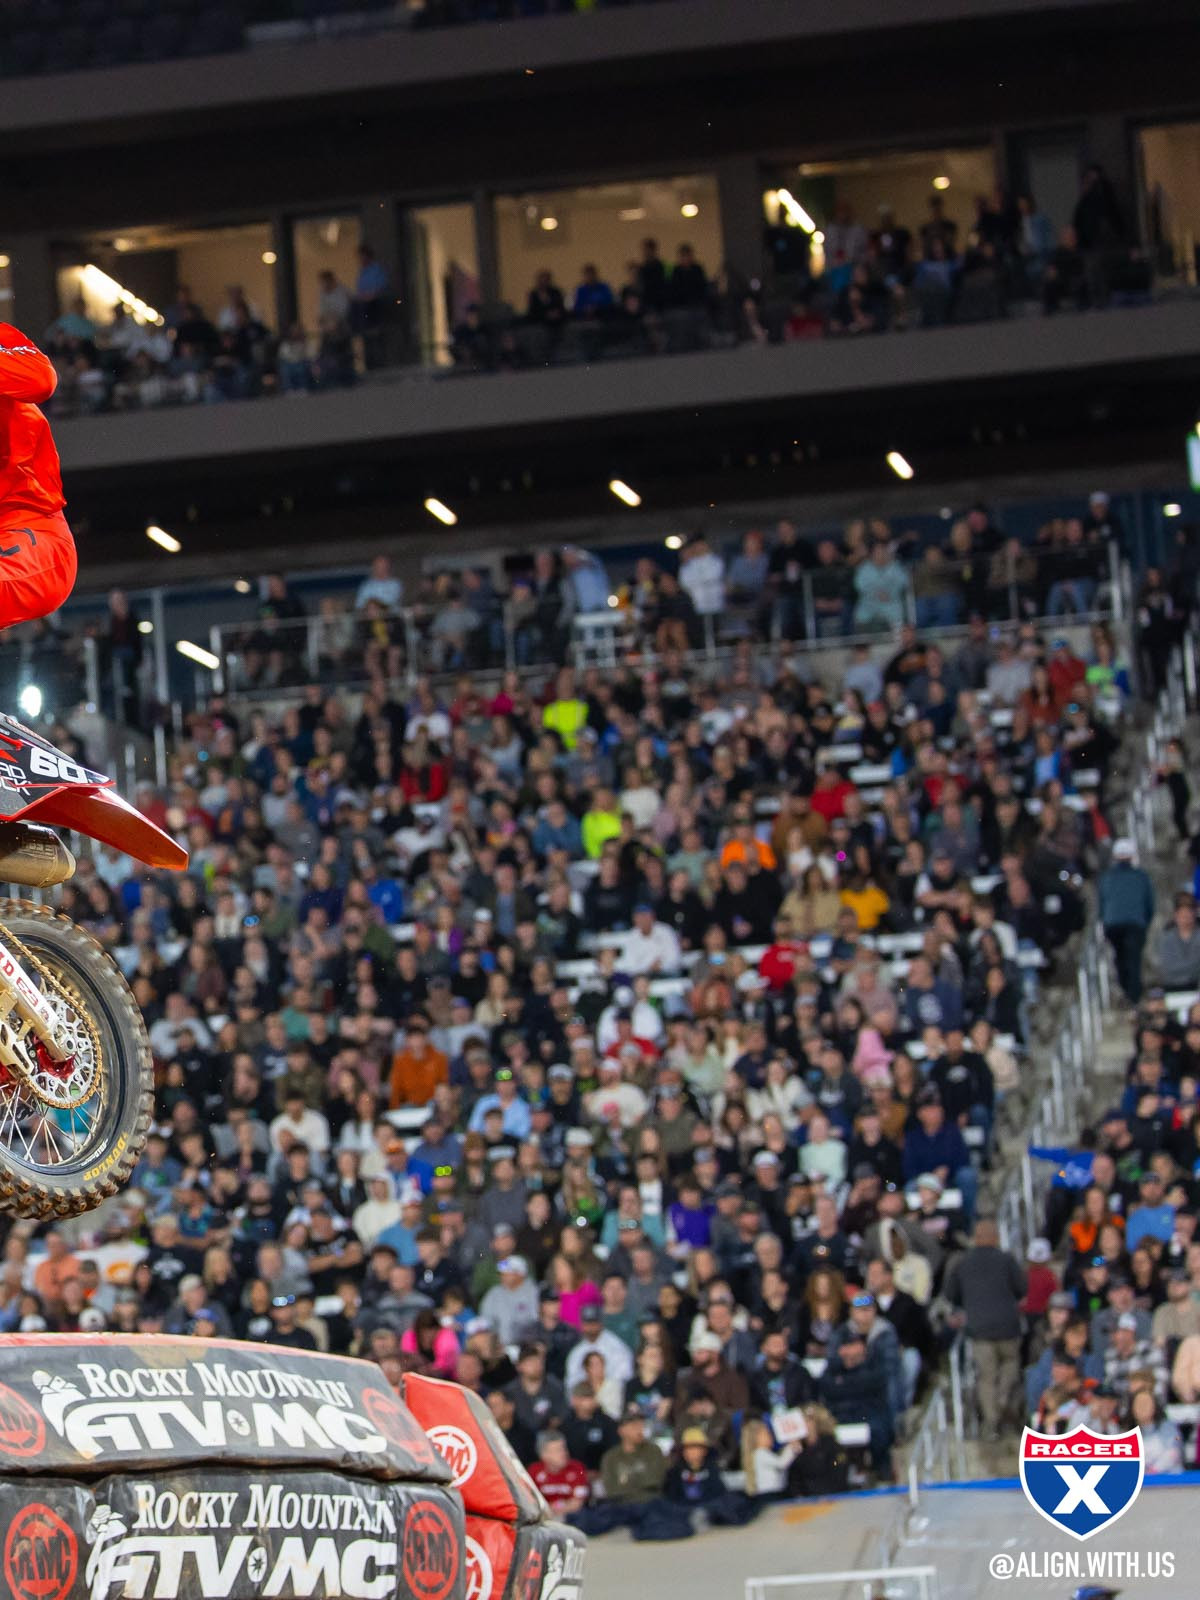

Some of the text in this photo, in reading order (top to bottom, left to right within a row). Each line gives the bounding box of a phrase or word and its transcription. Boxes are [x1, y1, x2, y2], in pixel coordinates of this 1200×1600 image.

[83, 1136, 127, 1181] DUNLOP
[77, 1362, 354, 1409] ROCKY MOUNTAIN
[64, 1401, 227, 1460] ATV
[252, 1402, 387, 1453] MC
[132, 1484, 239, 1530] ROCKY
[262, 1536, 398, 1599] MC
